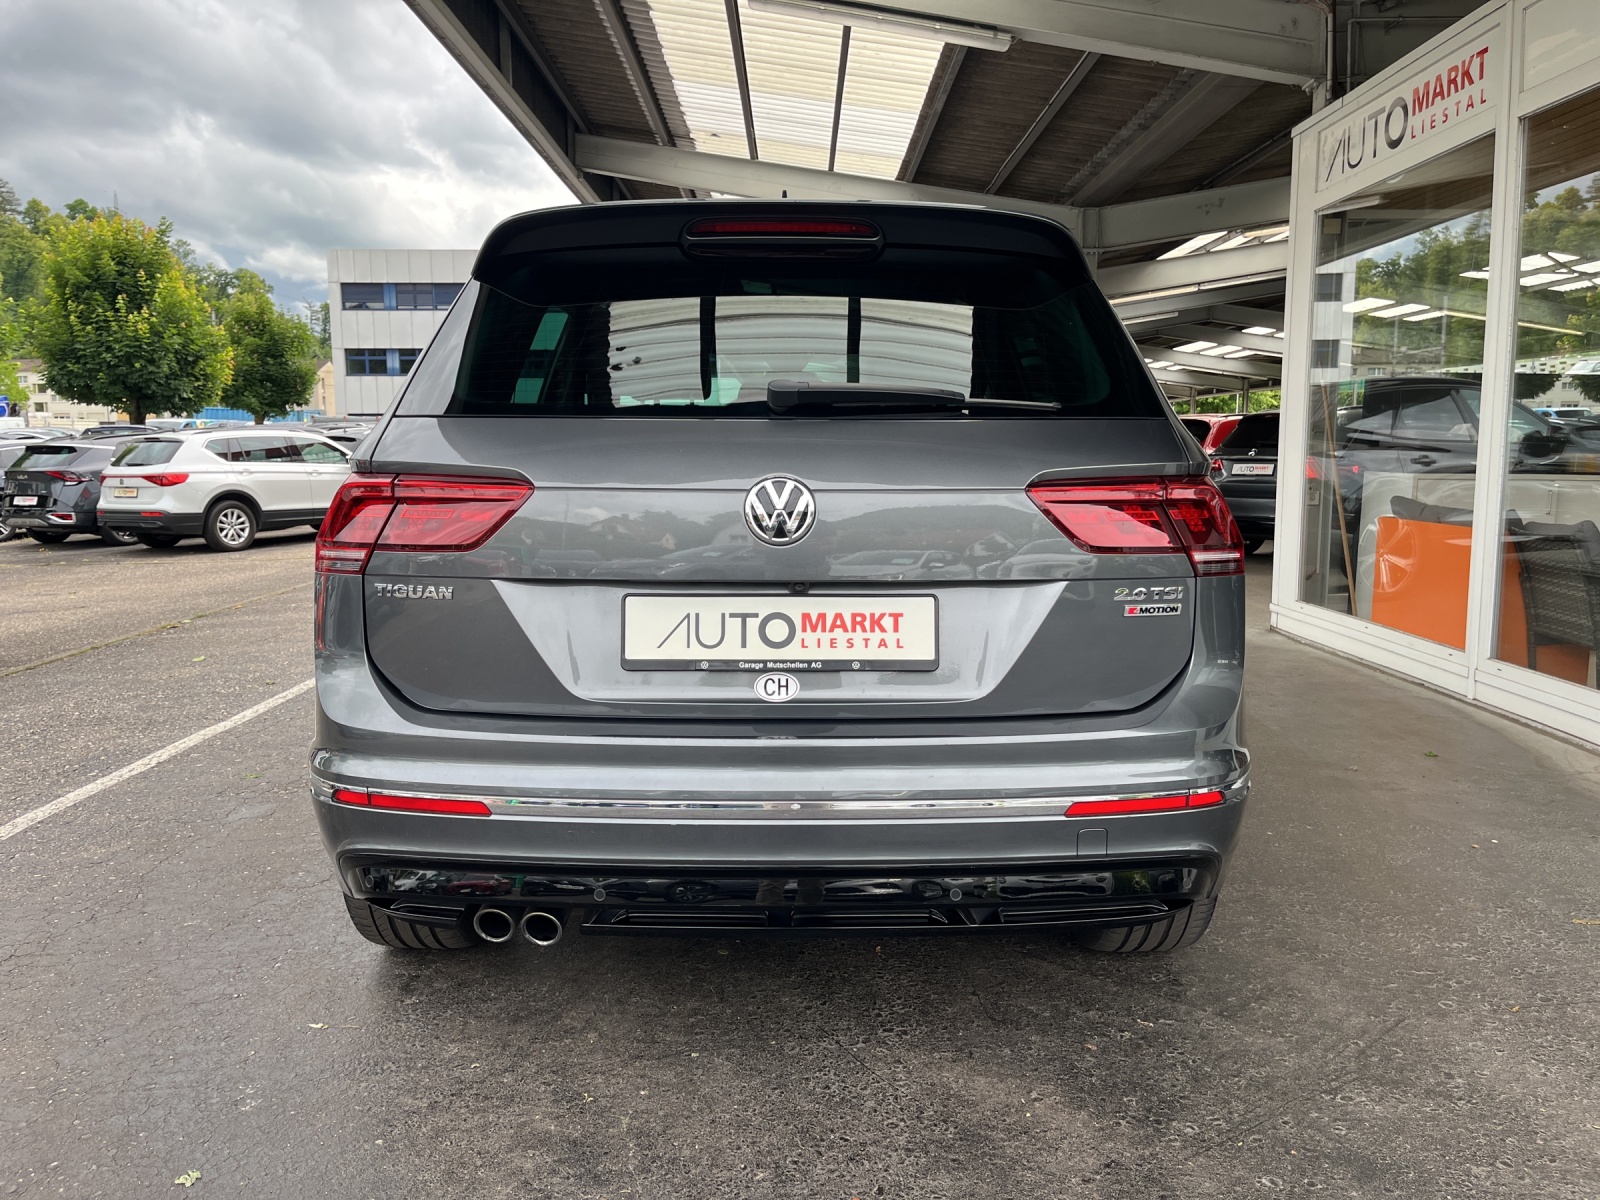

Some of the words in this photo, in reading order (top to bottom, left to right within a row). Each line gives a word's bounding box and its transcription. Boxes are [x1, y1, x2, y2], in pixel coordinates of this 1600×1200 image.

[1325, 96, 1409, 182] AUTO
[1411, 46, 1489, 117] MARKT
[1410, 88, 1487, 140] LIESTAL
[373, 582, 454, 600] TIGUAN
[1150, 586, 1184, 600] TSI
[656, 611, 797, 650] AUTO
[800, 612, 904, 633] MARKT
[800, 637, 905, 649] LIESTAL
[738, 661, 764, 670] Garage
[766, 661, 808, 669] Mutschellen
[810, 661, 822, 669] AG
[763, 677, 789, 697] CH
